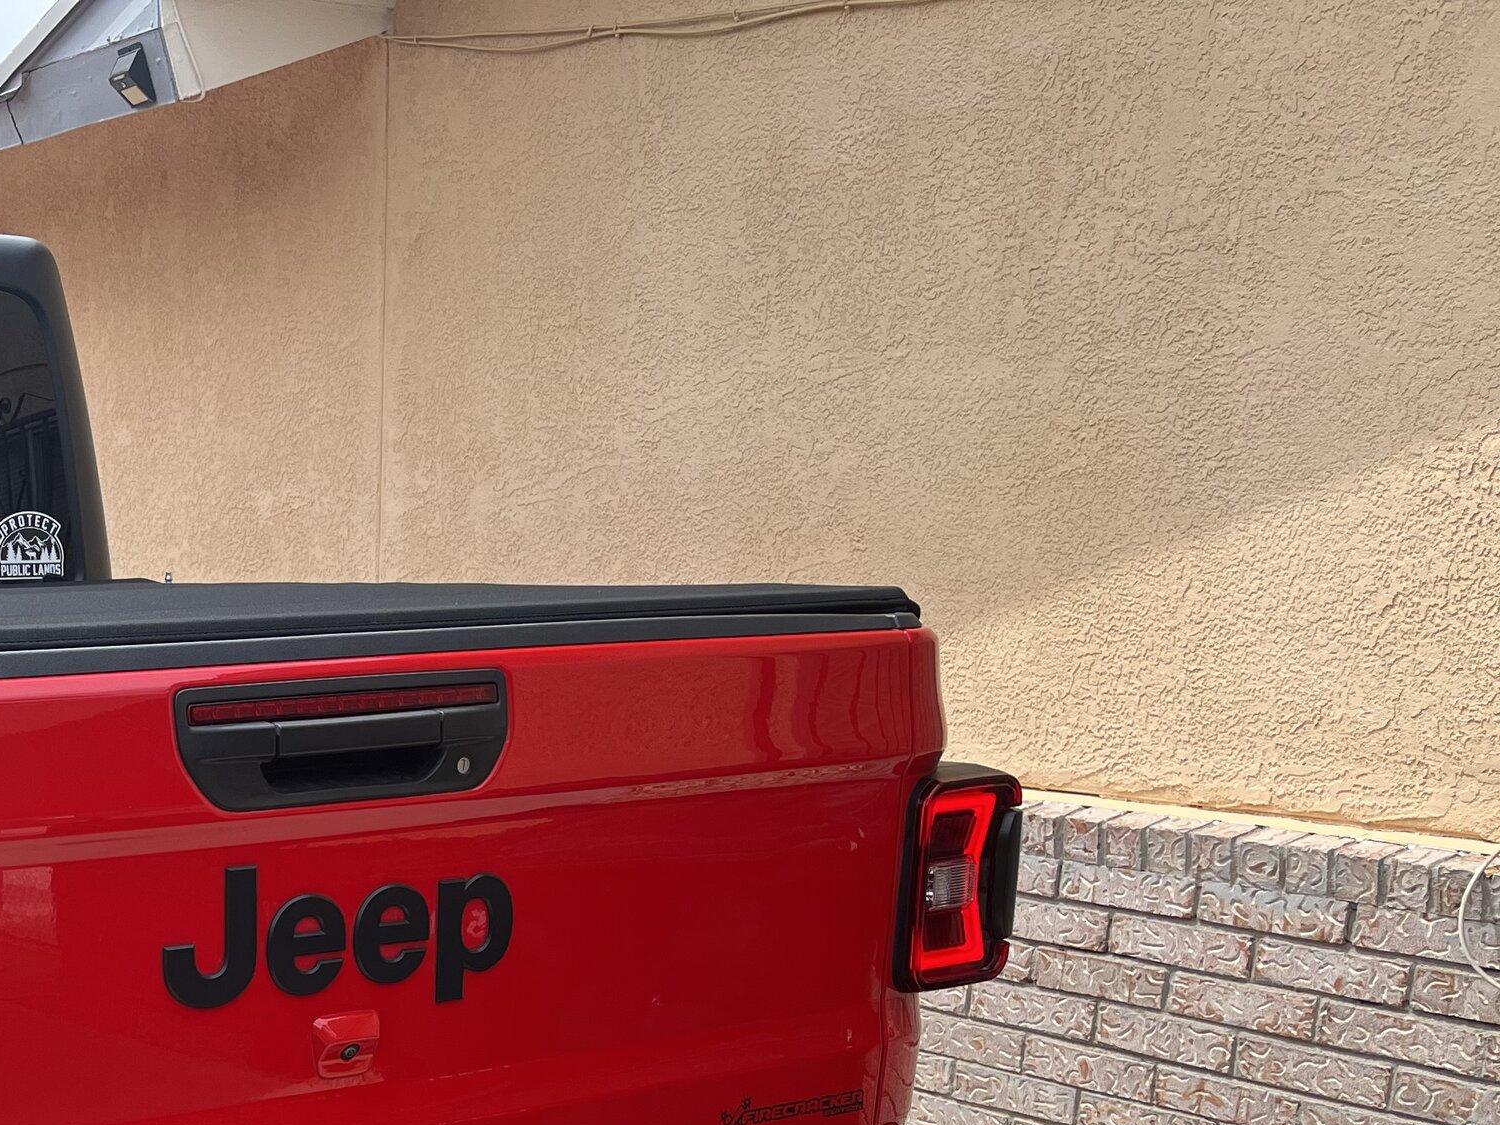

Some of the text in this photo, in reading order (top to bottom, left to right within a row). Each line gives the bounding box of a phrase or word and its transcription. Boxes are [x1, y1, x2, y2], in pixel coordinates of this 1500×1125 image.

[0, 514, 58, 536] PROTECT
[0, 563, 61, 577] PUBLIC LANDS
[162, 864, 514, 1009] Jeep
[741, 1090, 864, 1125] FIRECRACKER
